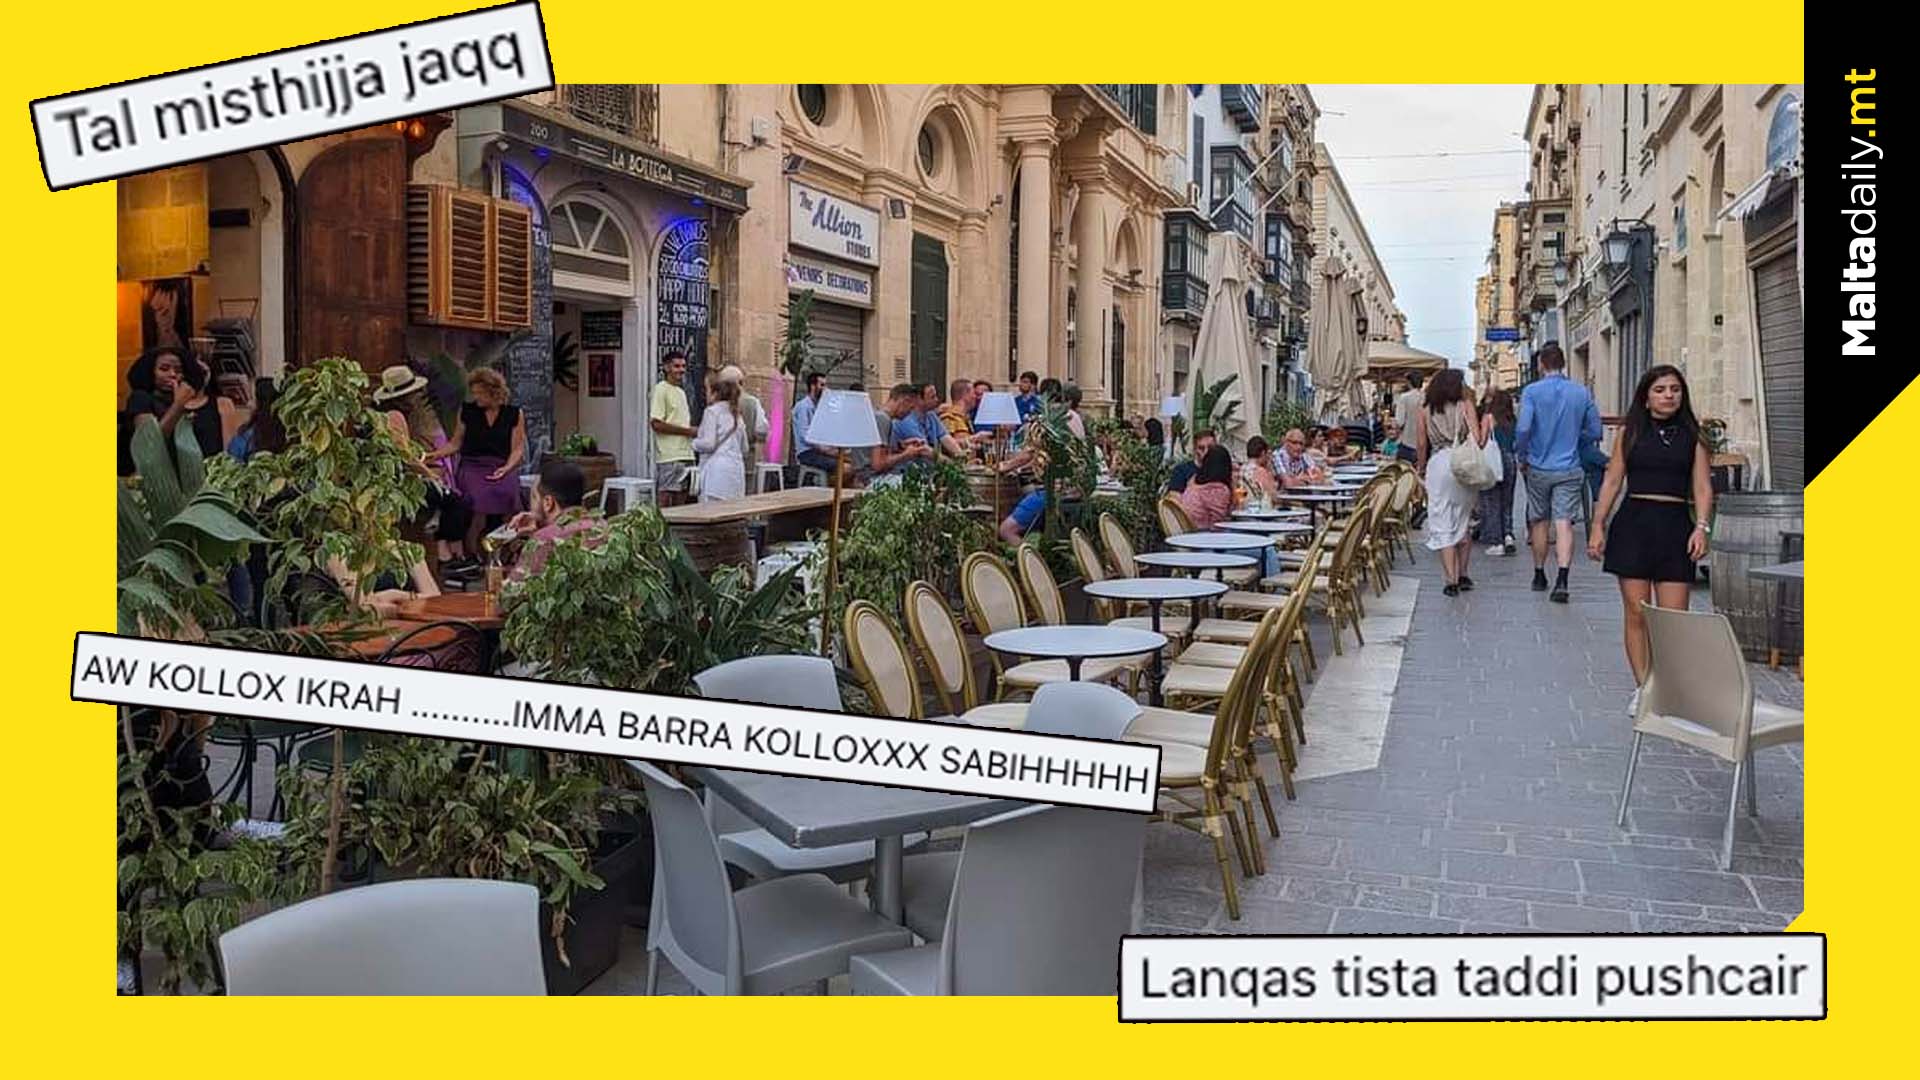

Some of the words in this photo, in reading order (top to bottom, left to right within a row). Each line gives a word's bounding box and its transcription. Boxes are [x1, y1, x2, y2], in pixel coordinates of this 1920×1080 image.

[611, 147, 625, 169] LA
[629, 155, 673, 181] BOTTEGA
[799, 191, 814, 212] The
